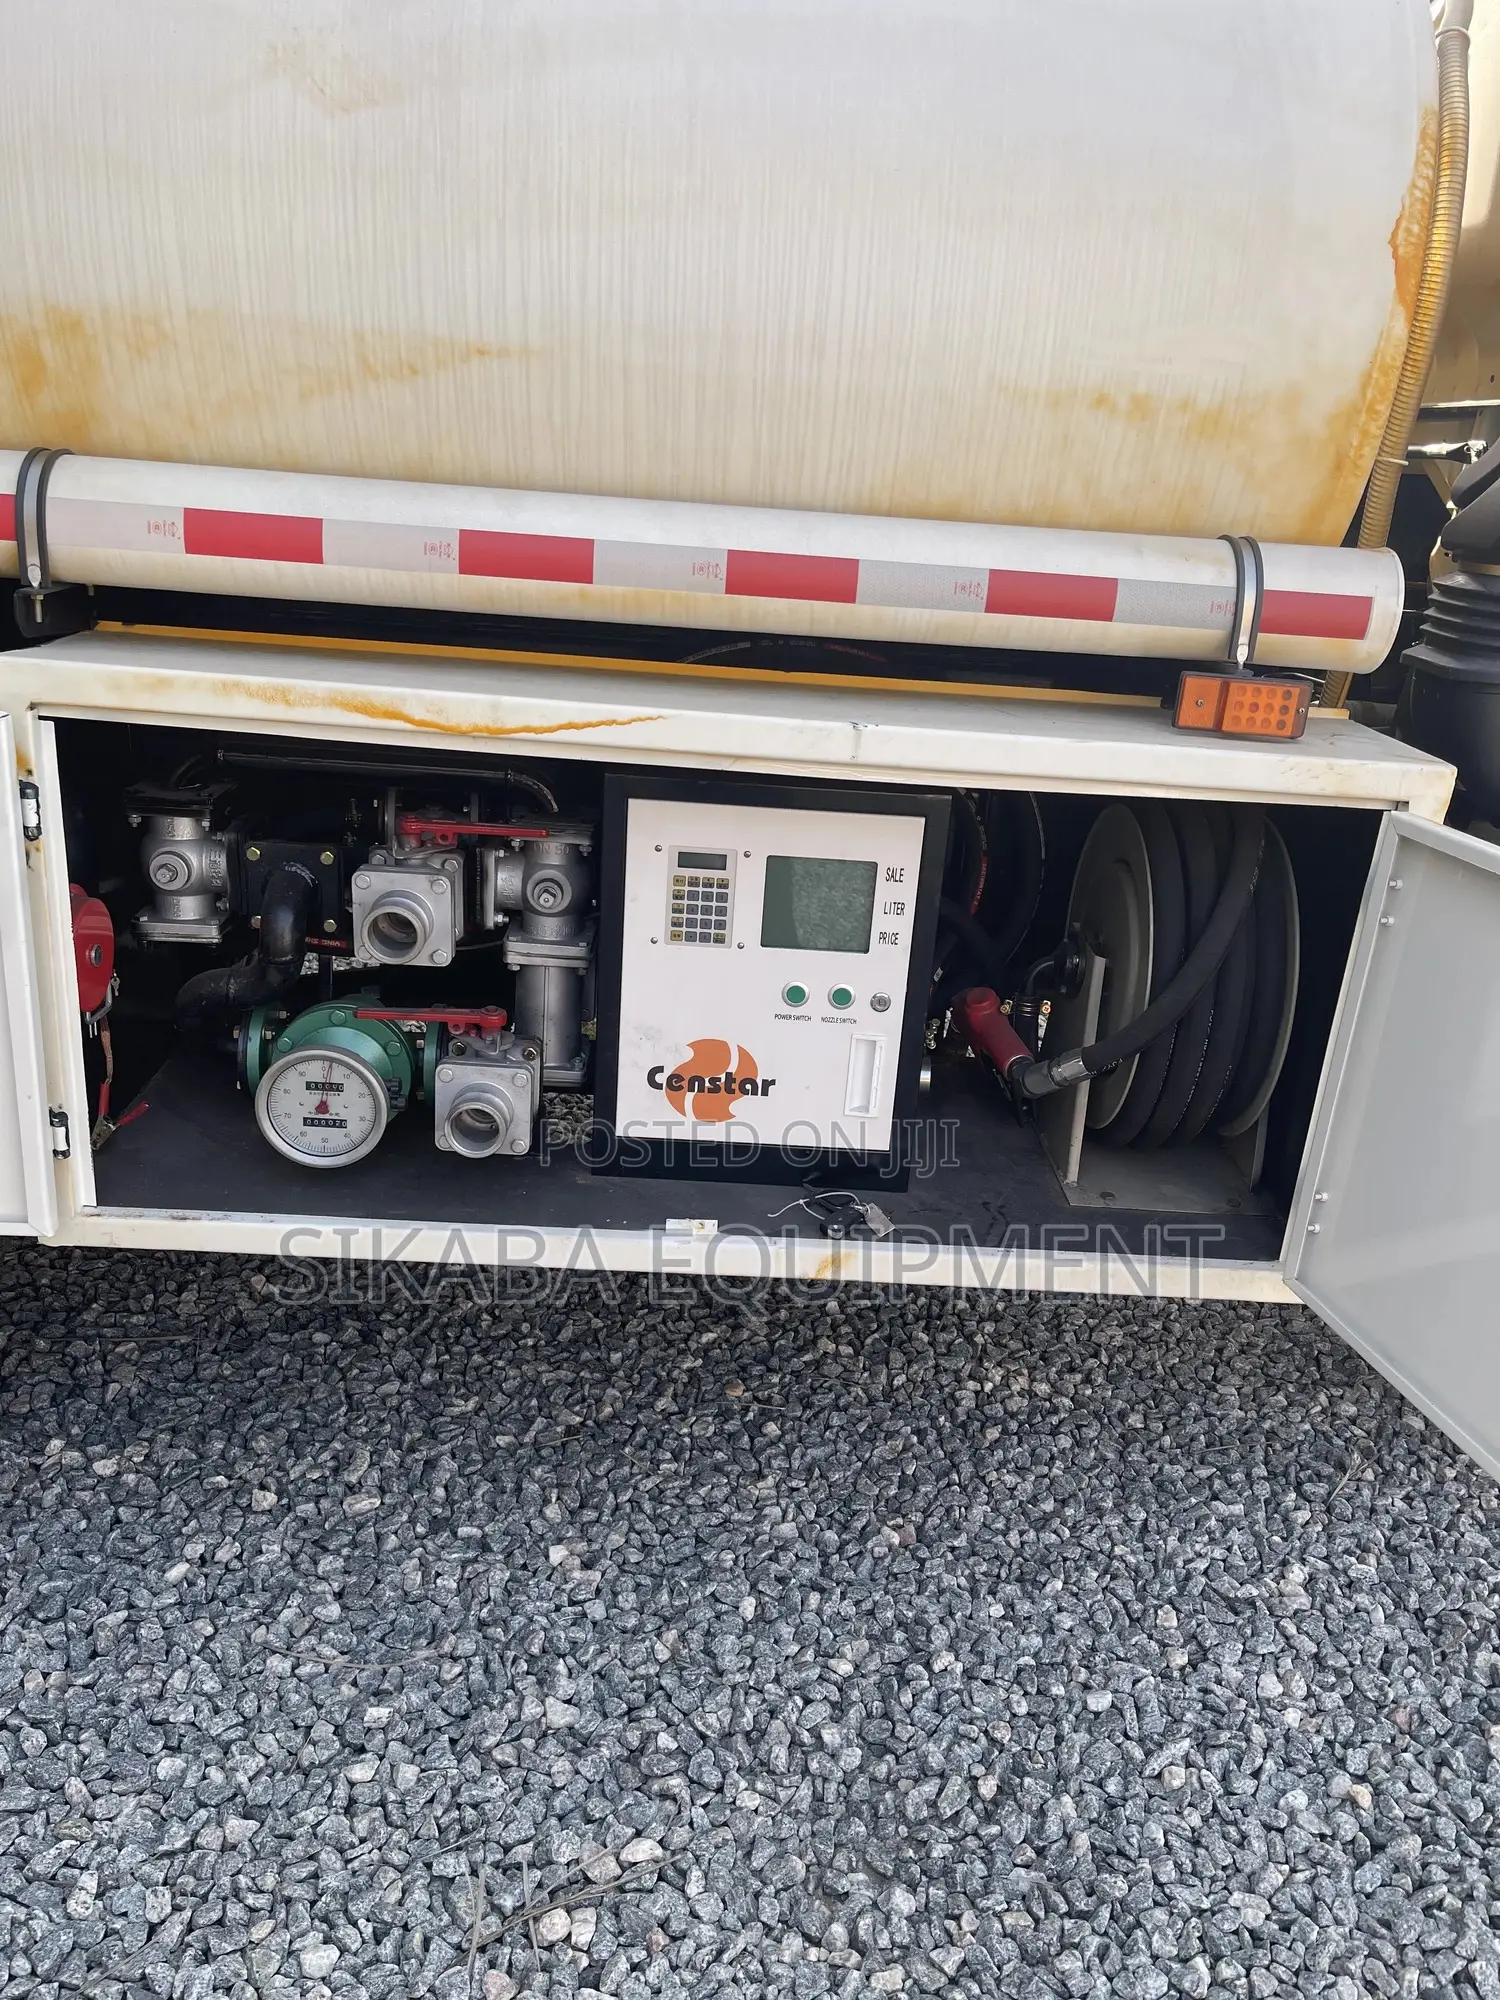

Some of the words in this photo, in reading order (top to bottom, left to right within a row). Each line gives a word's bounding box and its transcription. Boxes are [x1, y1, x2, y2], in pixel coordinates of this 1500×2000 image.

[885, 867, 905, 883] SALE
[883, 901, 906, 916] LITER
[878, 931, 900, 946] PRICE
[792, 1014, 812, 1022] SWITCH
[820, 1016, 839, 1024] NOZZLE
[646, 1065, 777, 1098] Censtar
